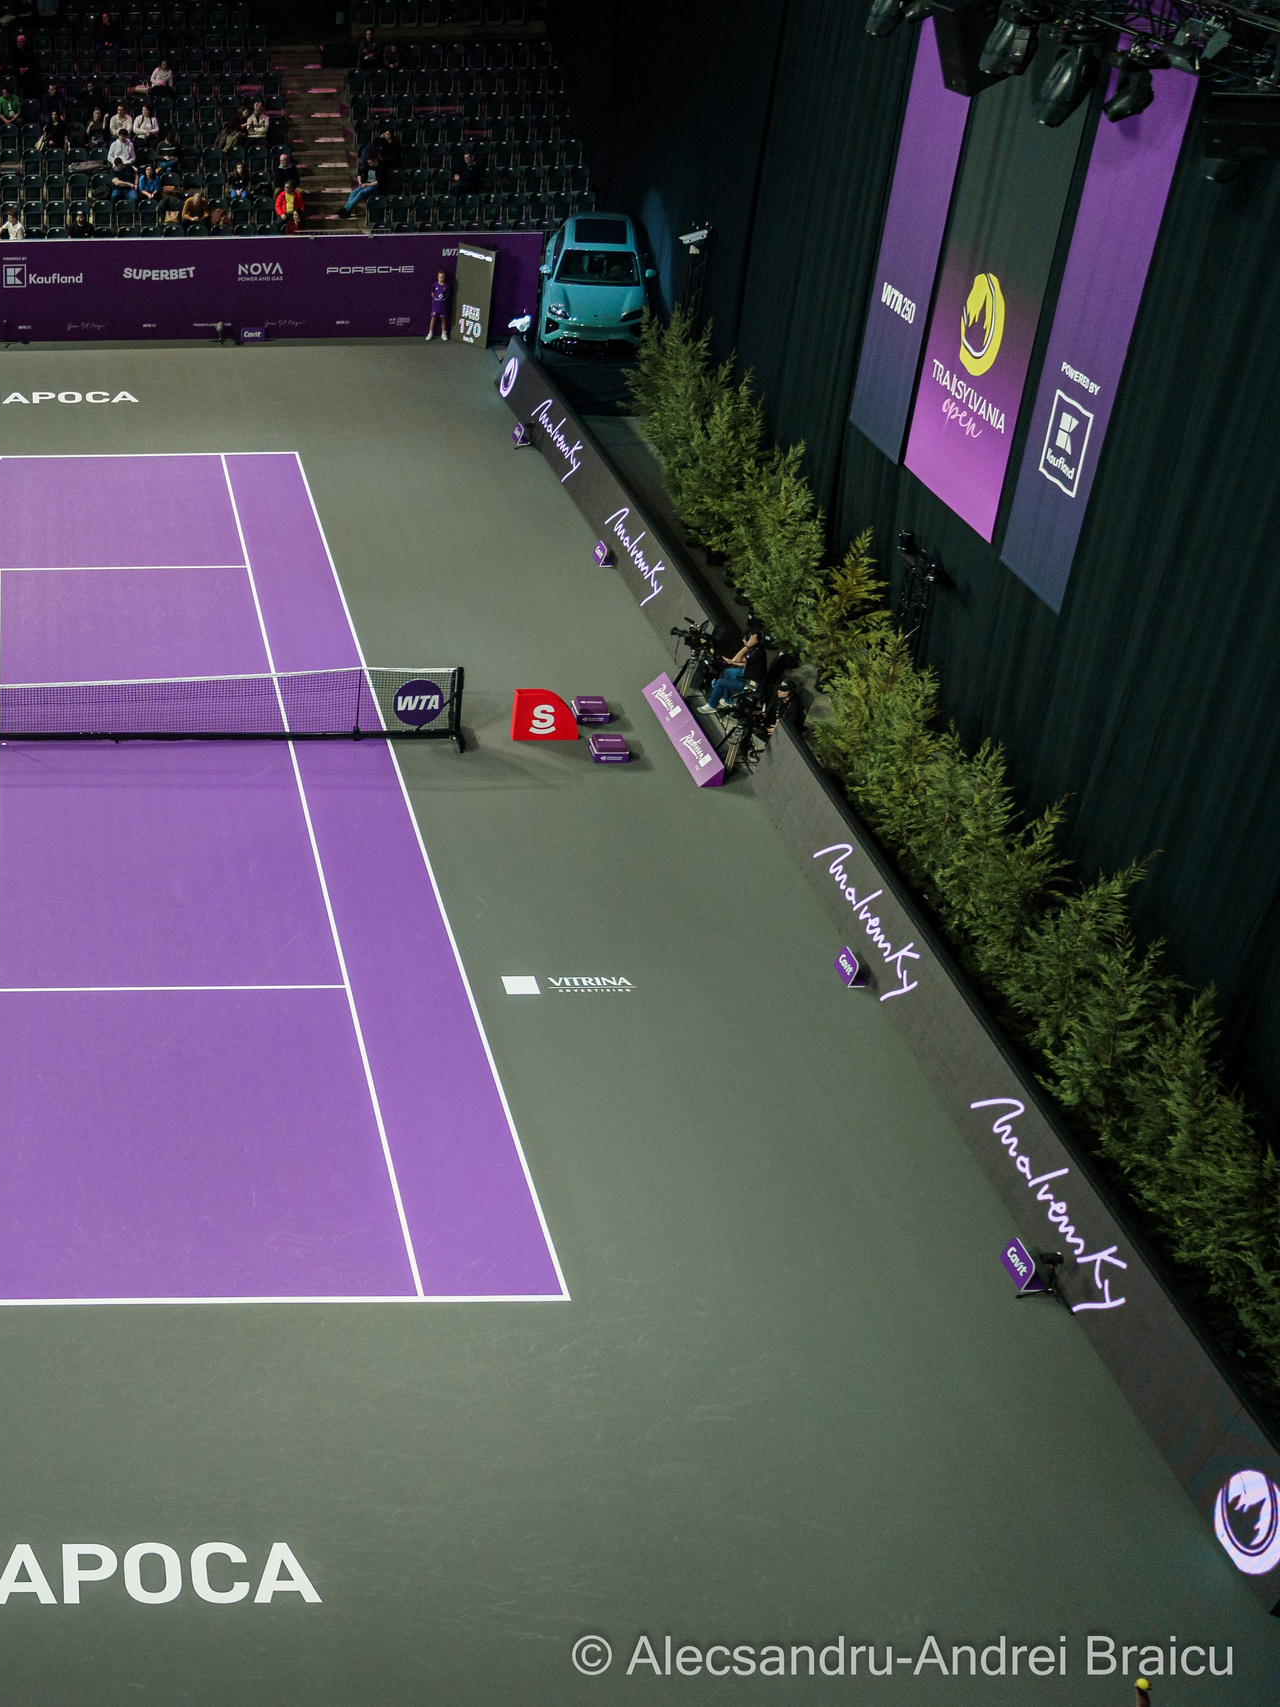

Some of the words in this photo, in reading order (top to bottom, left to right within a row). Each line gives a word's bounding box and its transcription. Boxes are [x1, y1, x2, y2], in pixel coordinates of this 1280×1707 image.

[29, 272, 83, 284] Kaufland
[122, 266, 195, 281] SUPERBET
[238, 262, 284, 276] NOVA
[326, 266, 414, 274] PORSCHE
[459, 318, 481, 338] 170
[1061, 362, 1090, 390] POWERED
[1088, 379, 1100, 396] BY
[932, 359, 1006, 434] TRANSYLVANIA
[942, 398, 982, 438] open
[1046, 448, 1075, 480] Kaufland
[397, 694, 440, 711] WTA
[838, 954, 854, 976] Cavit
[548, 976, 632, 986] VITRINA
[1007, 1246, 1028, 1276] Cavit
